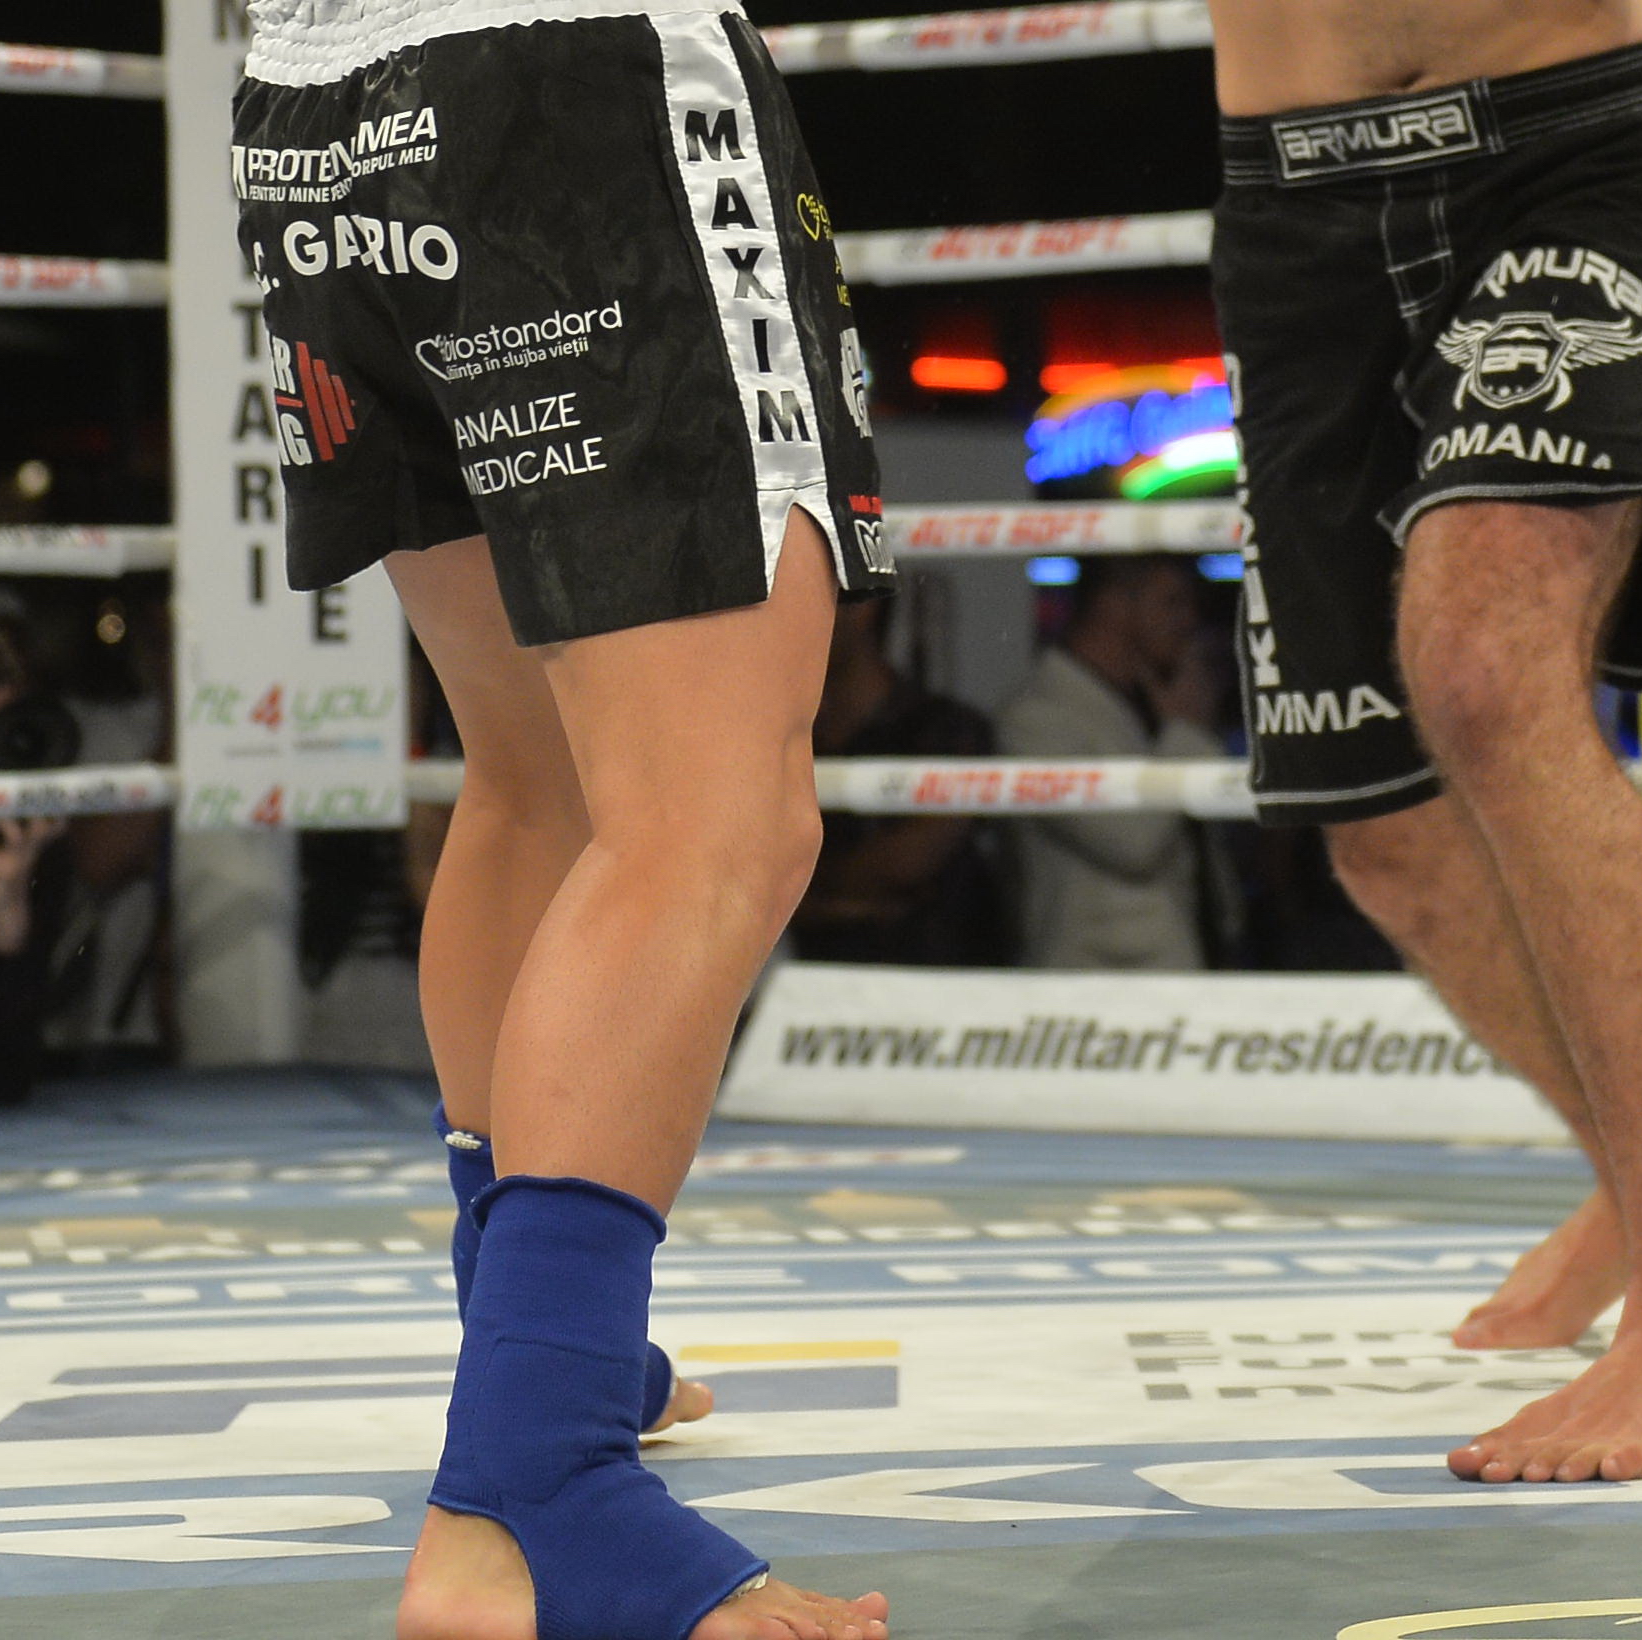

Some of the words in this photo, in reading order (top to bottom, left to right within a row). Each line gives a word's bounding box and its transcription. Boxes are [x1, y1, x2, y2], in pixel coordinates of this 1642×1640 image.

[357, 107, 438, 156] MEA
[288, 187, 330, 203] MINE
[398, 144, 438, 166] MEU
[684, 108, 812, 443] MAXIM
[454, 392, 581, 450] ANALIZE
[461, 437, 608, 496] MEDICALE
[1257, 684, 1401, 734] MMA
